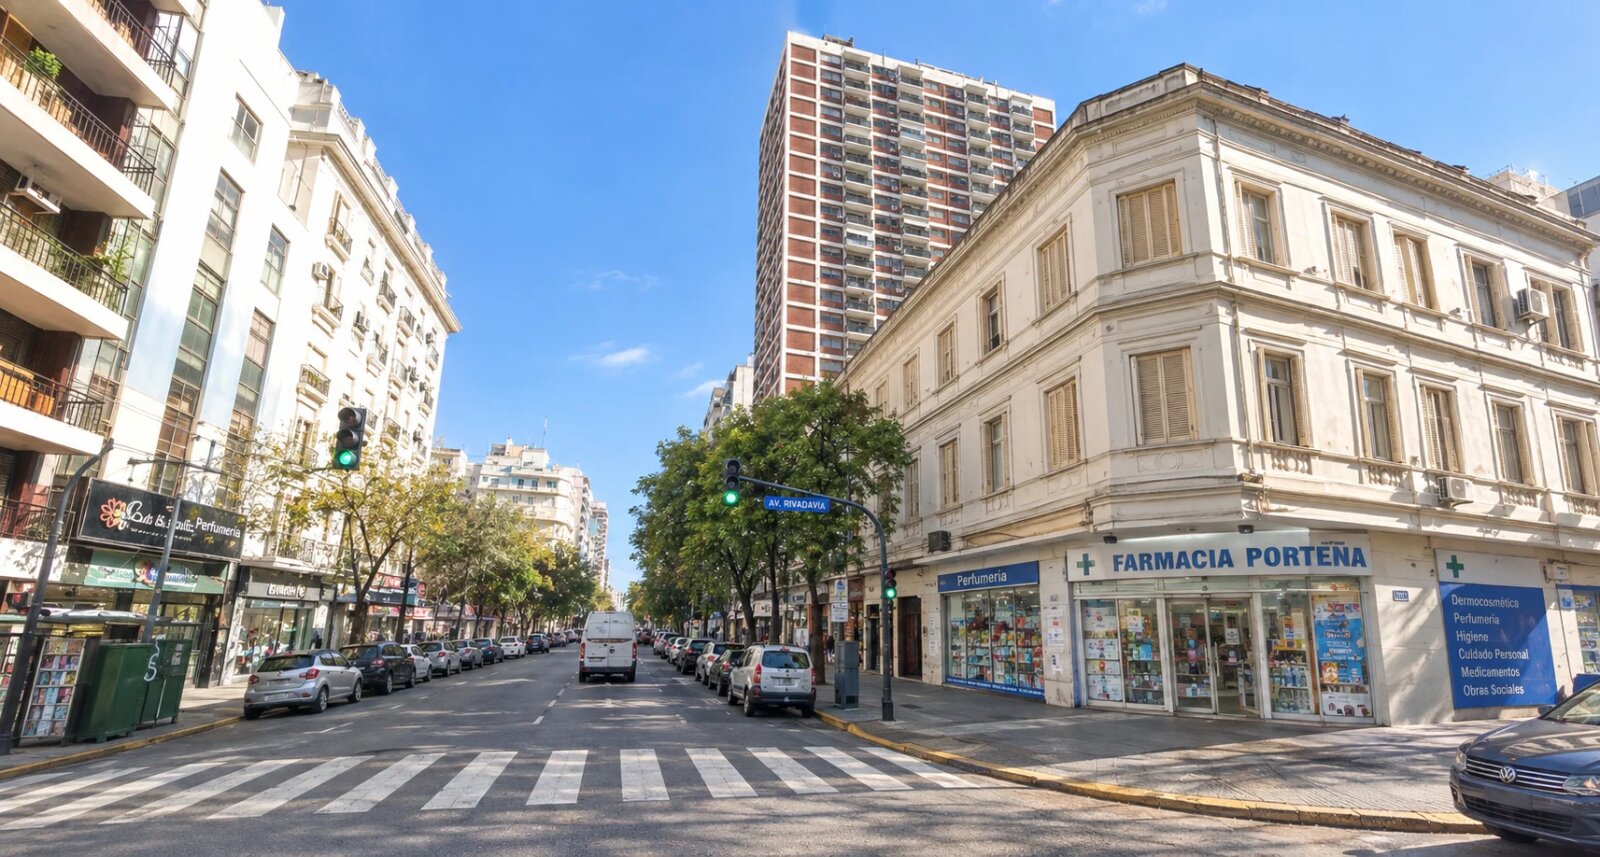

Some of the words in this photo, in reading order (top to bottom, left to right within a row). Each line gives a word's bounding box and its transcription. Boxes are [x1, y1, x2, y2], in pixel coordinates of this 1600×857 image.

[769, 499, 782, 508] AV.
[783, 499, 826, 510] RIVADAVIA
[1112, 548, 1234, 572] FARMACIA
[1451, 594, 1520, 609] Dermocosmética
[1456, 630, 1489, 644] Higiene
[1494, 648, 1530, 660] Personal
[1461, 666, 1521, 678] Medicamentos
[1463, 684, 1489, 697] Obras
[1490, 684, 1525, 696] Sociales
